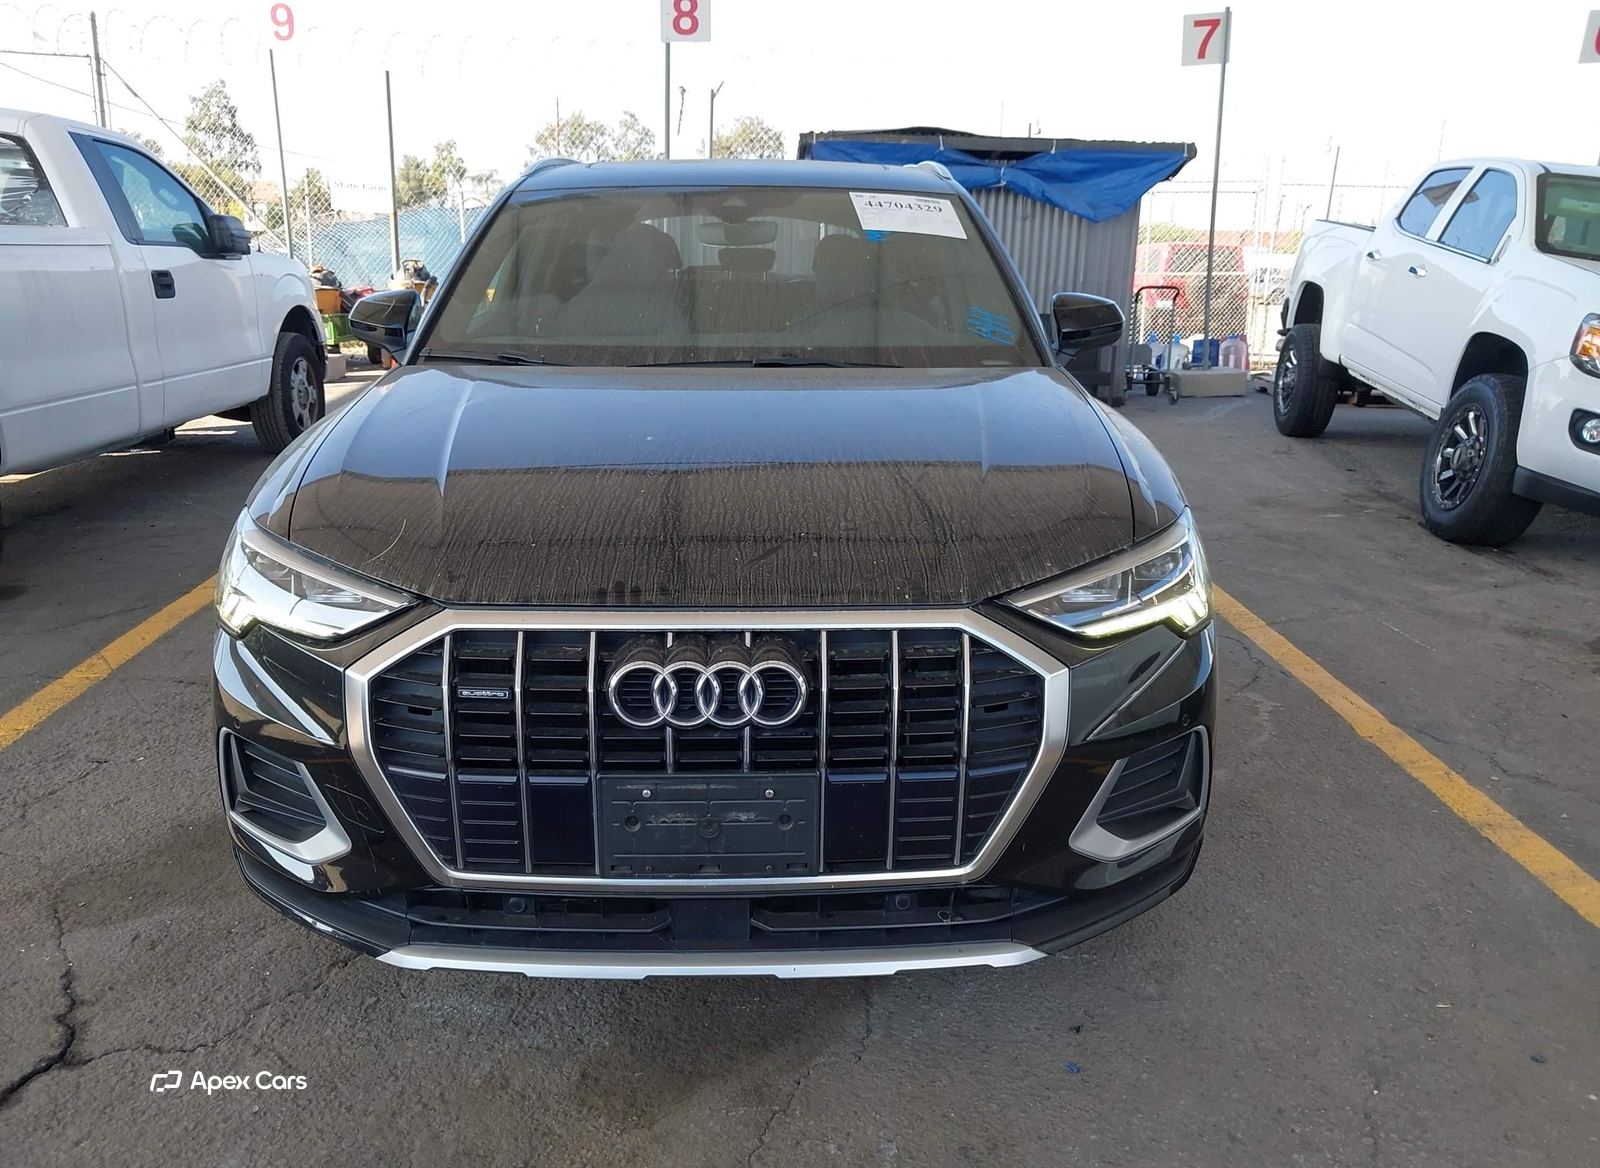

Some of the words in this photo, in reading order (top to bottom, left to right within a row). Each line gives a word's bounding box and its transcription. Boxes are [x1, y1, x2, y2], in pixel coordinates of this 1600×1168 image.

[270, 2, 294, 41] 9
[672, 0, 699, 36] 8
[1193, 18, 1221, 60] 7
[864, 200, 943, 213] 44704329
